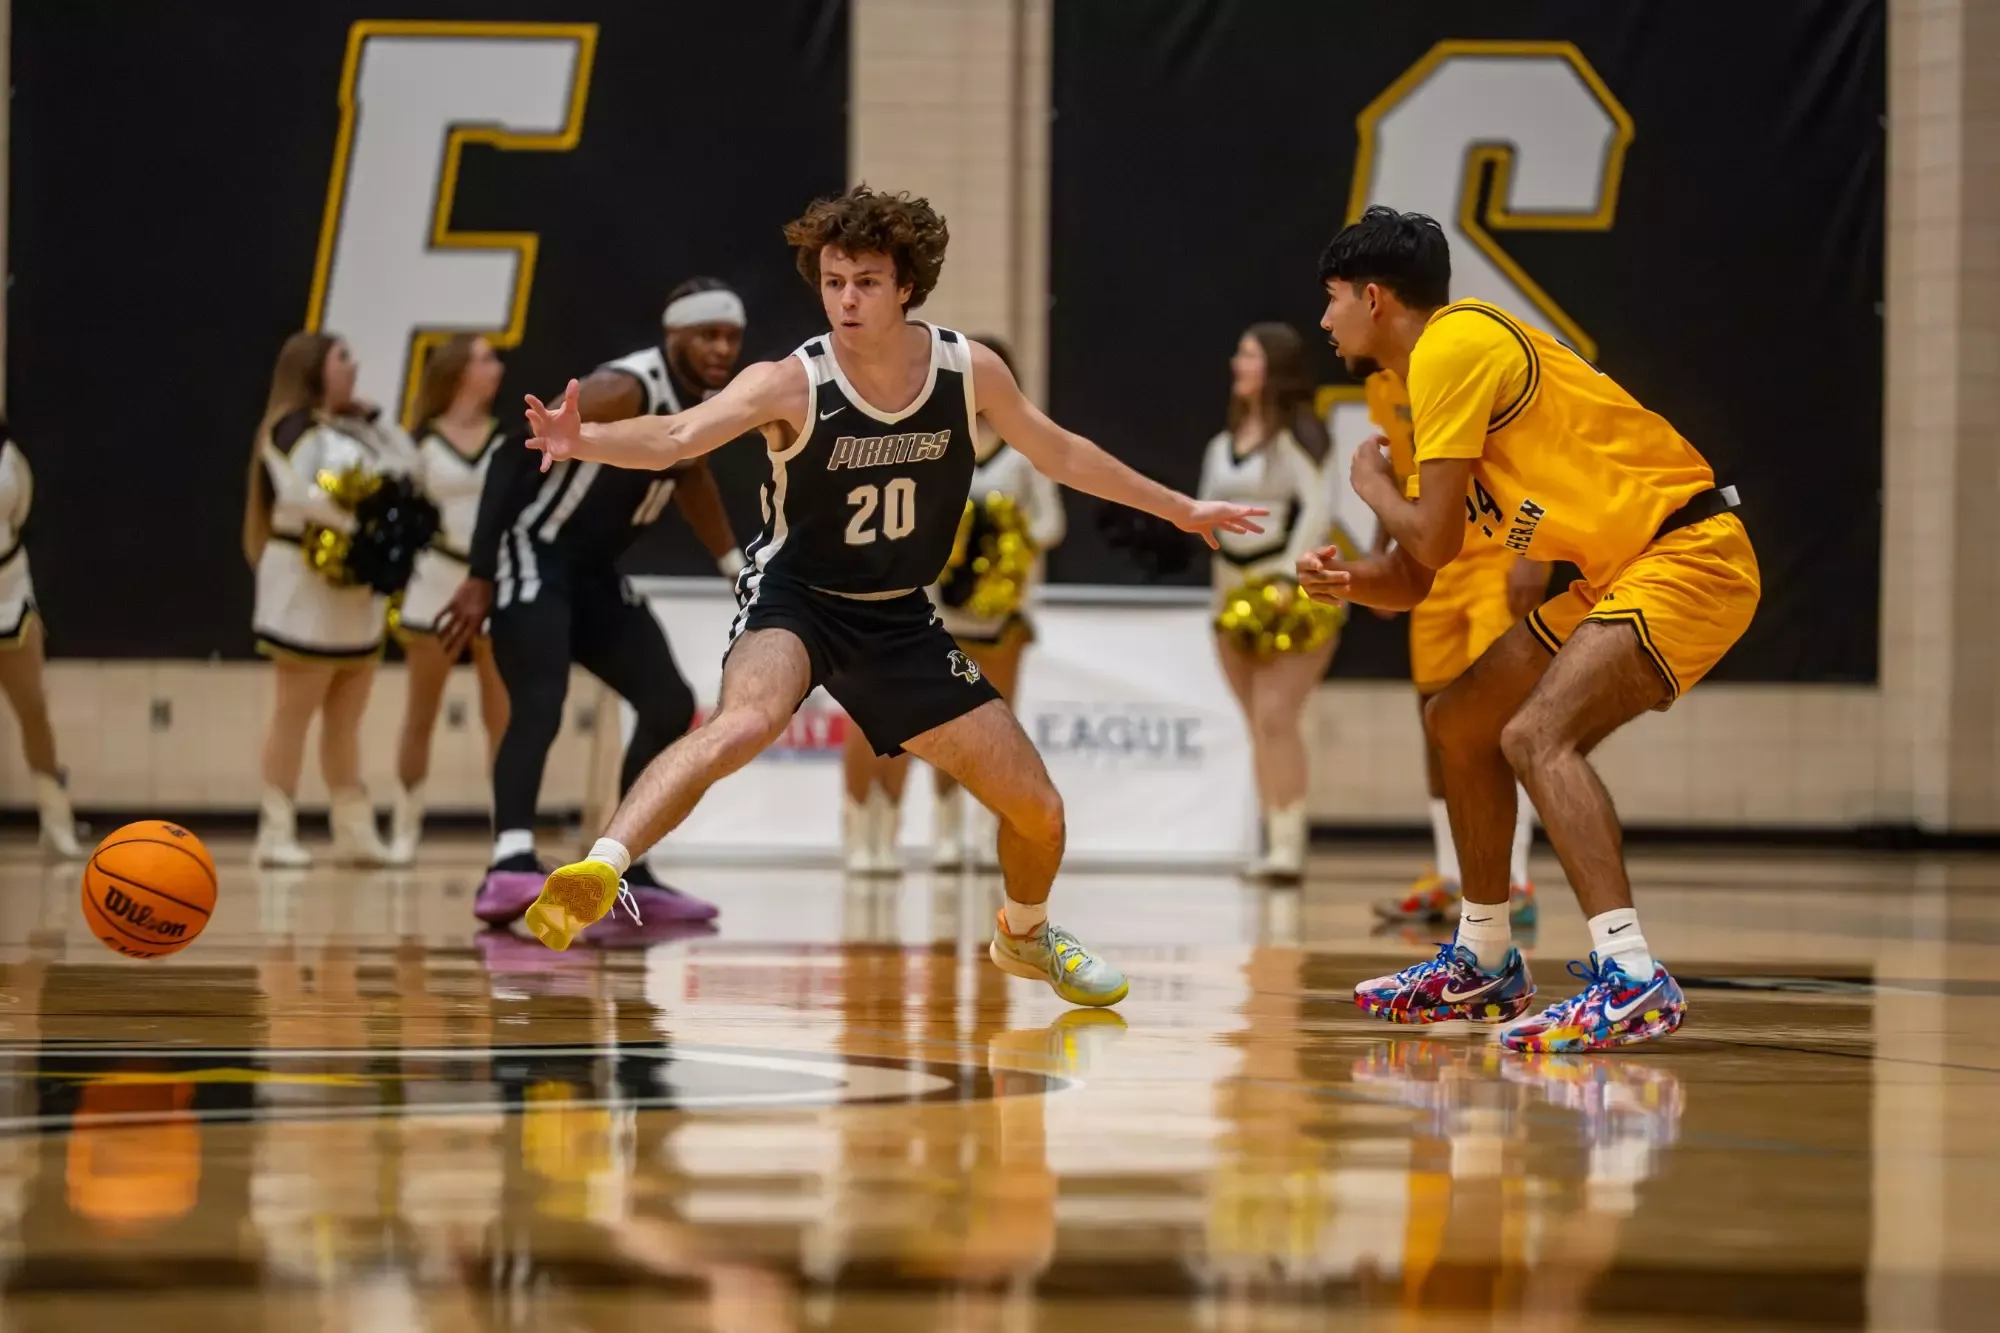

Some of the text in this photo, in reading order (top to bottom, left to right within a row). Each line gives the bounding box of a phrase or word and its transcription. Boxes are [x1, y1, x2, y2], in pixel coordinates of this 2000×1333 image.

[826, 429, 952, 471] PIRATES
[844, 477, 918, 545] 20
[1504, 498, 1546, 556] HERAN
[1034, 713, 1204, 761] EAGUE
[104, 884, 188, 937] Wilson
